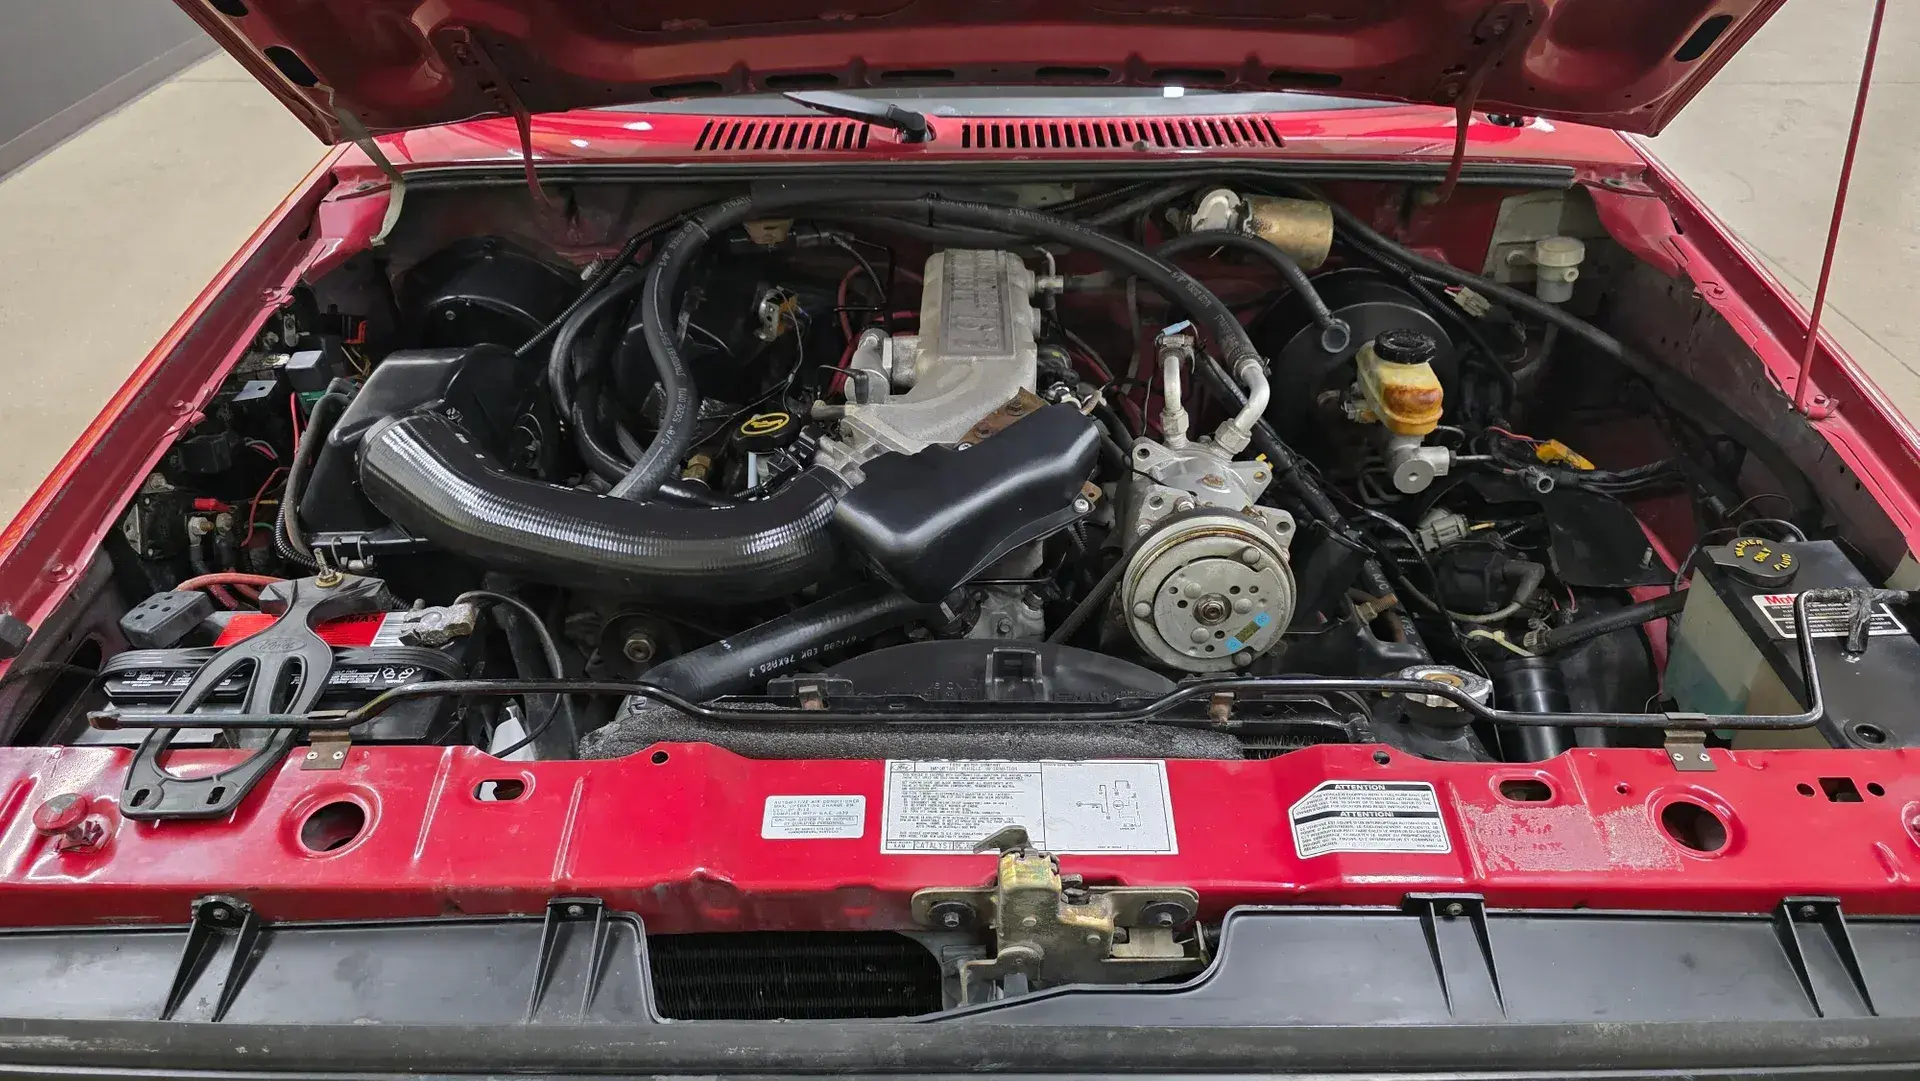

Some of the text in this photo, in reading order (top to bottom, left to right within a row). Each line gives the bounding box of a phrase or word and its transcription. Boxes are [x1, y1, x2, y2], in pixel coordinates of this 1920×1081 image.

[1734, 538, 1764, 558] WASHER
[1753, 547, 1772, 562] ONLY
[1773, 553, 1792, 571] FLUID
[916, 840, 952, 849] CATALYST
